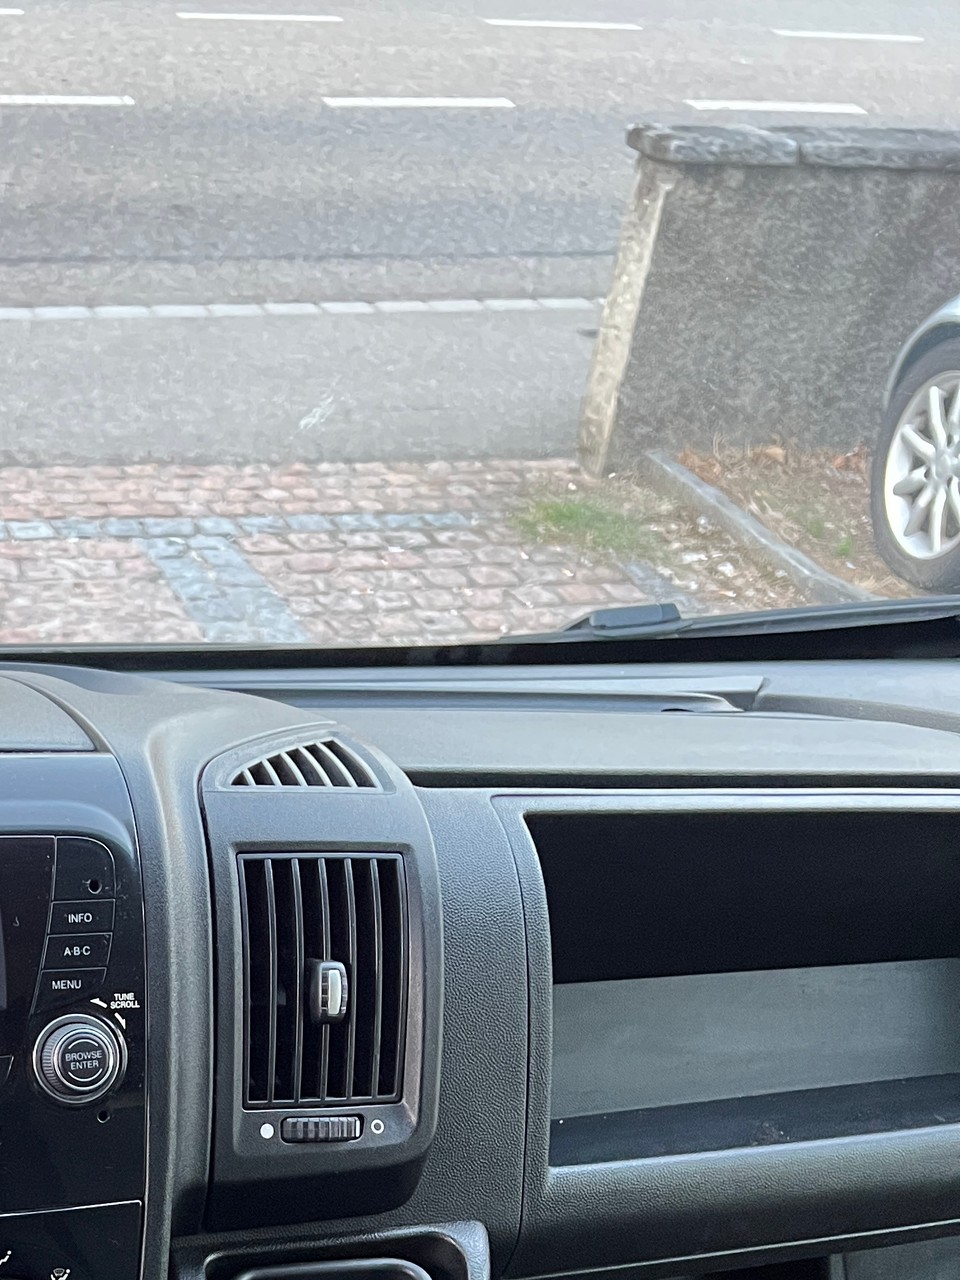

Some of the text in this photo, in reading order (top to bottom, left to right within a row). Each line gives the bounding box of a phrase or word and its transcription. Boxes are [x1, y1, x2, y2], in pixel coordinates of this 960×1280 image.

[68, 913, 93, 924] INFO
[51, 980, 82, 990] MENU
[113, 992, 135, 1001] TUNE
[110, 999, 140, 1009] SCROLL
[65, 1050, 103, 1062] BROWSE
[70, 1060, 99, 1071] ENTER
